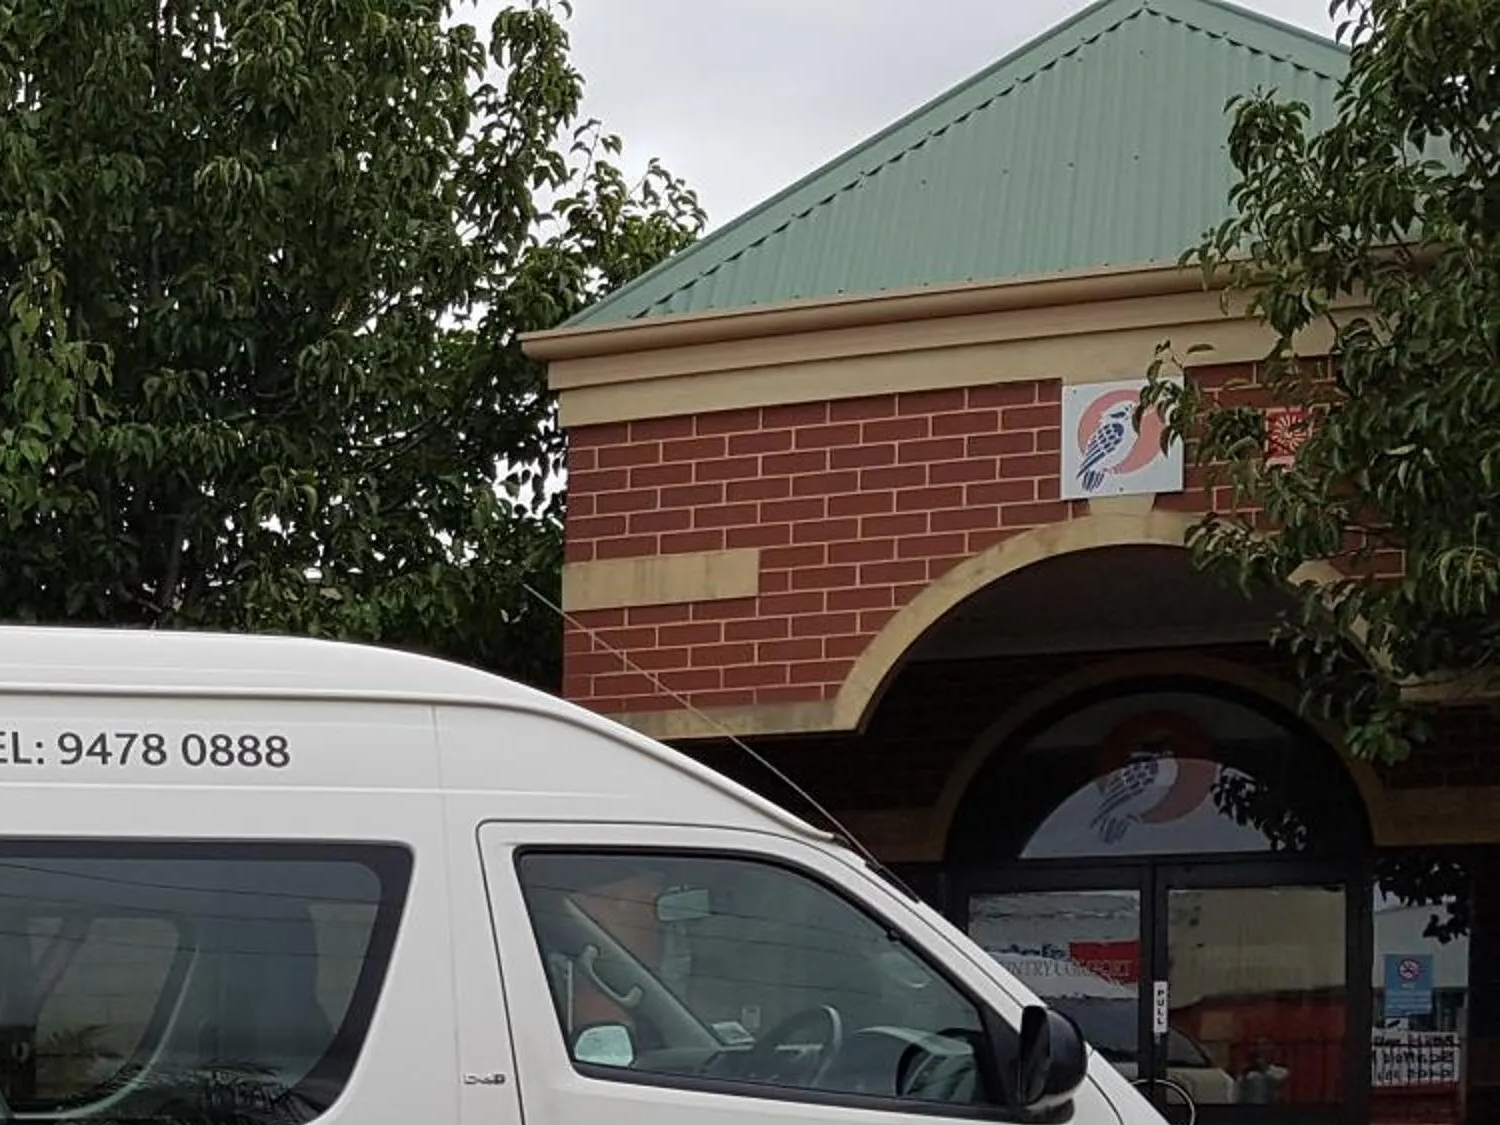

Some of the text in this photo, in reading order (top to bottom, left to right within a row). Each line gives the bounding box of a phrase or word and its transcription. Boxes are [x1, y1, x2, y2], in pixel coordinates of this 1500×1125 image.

[57, 731, 168, 767] 9478
[181, 733, 291, 769] 0888
[1156, 988, 1165, 1025] PULL
